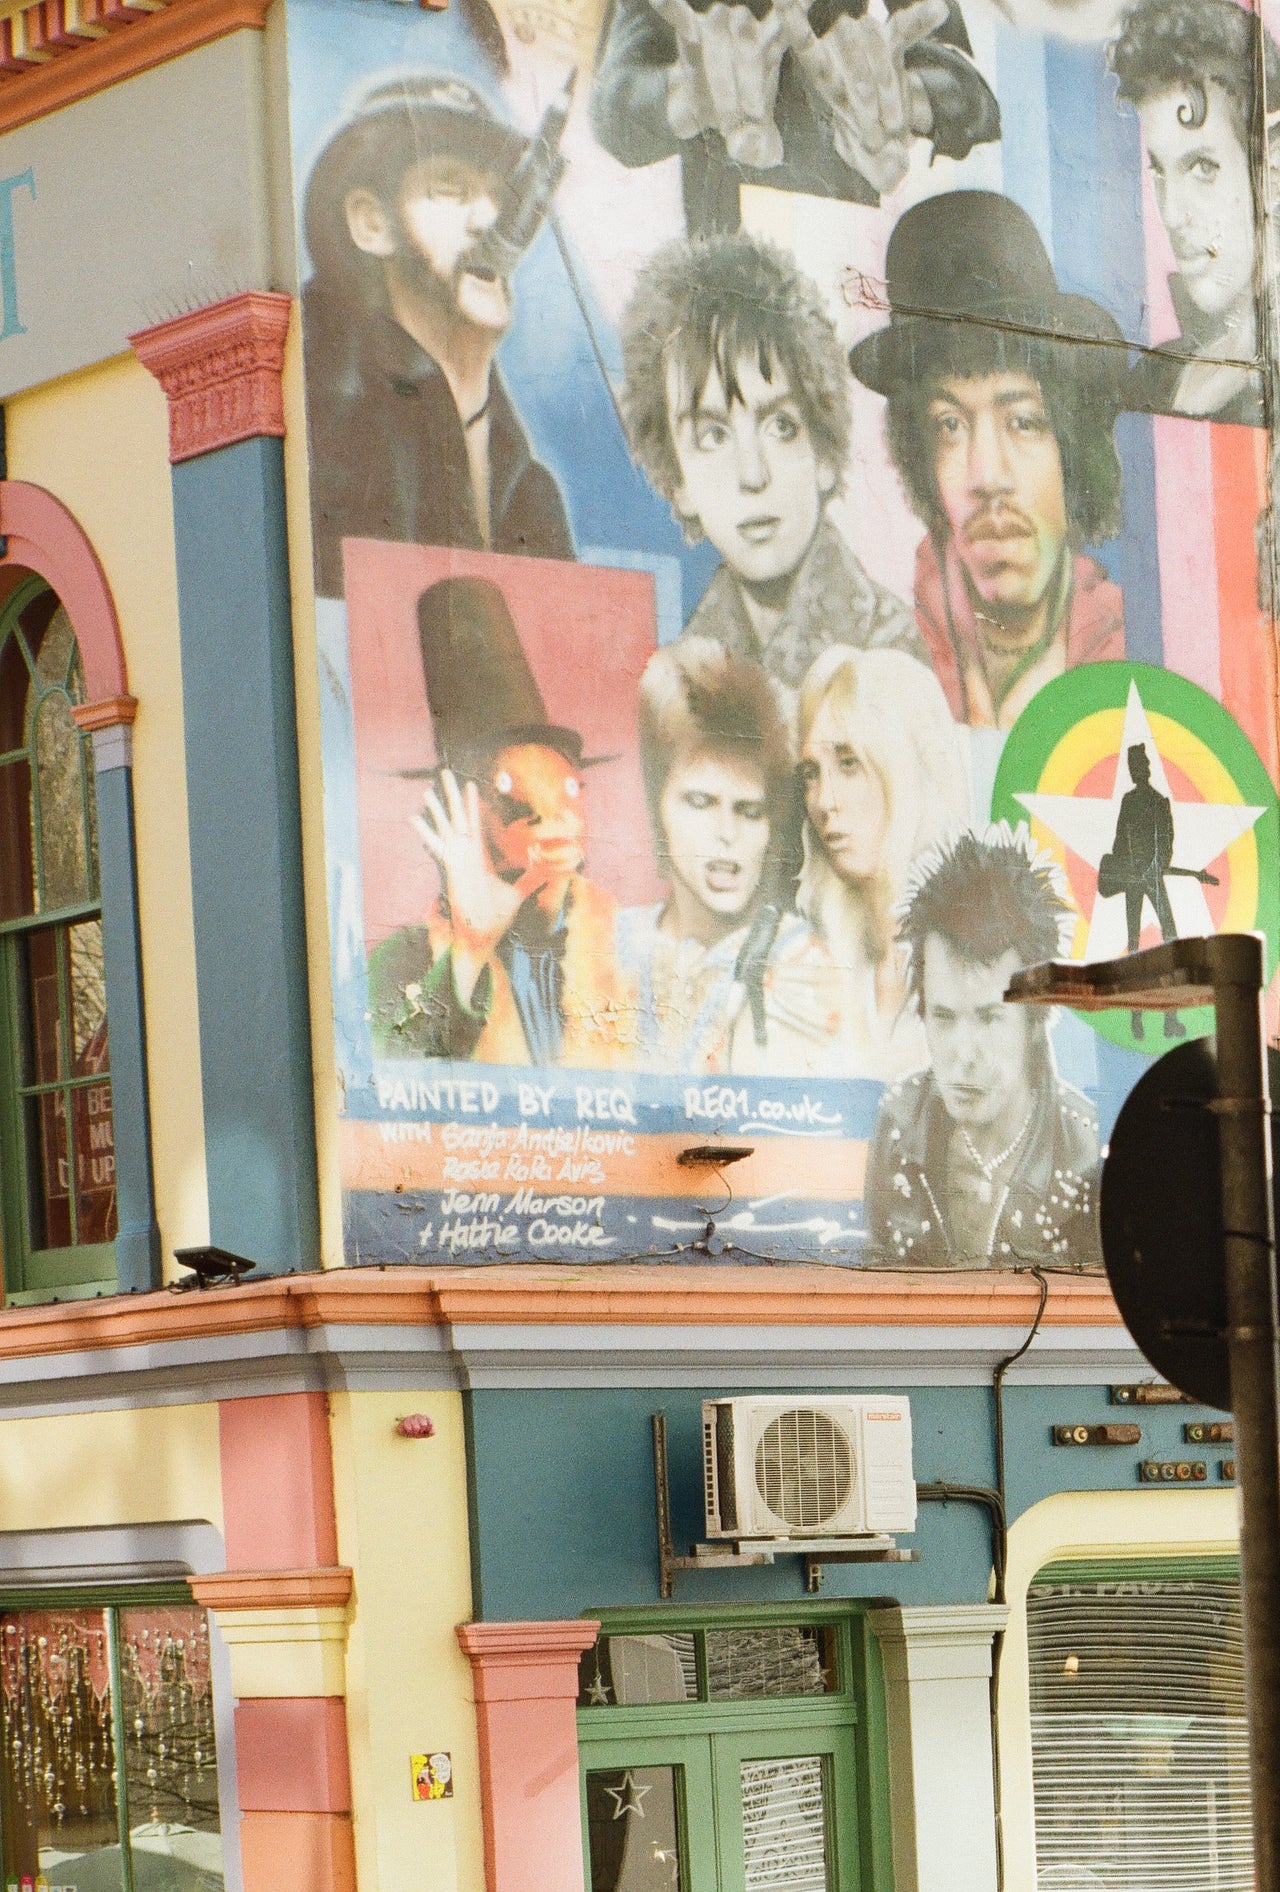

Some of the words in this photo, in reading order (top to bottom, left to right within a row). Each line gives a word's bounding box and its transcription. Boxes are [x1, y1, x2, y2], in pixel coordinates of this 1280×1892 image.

[377, 1079, 499, 1113] PAINTED
[518, 1083, 556, 1116] BY
[576, 1086, 637, 1125] REQ
[380, 1121, 431, 1143] WITH
[441, 1187, 499, 1215] Jenn
[504, 1186, 605, 1217] Marson
[438, 1215, 521, 1249] Hattie
[527, 1218, 618, 1246] Cooke
